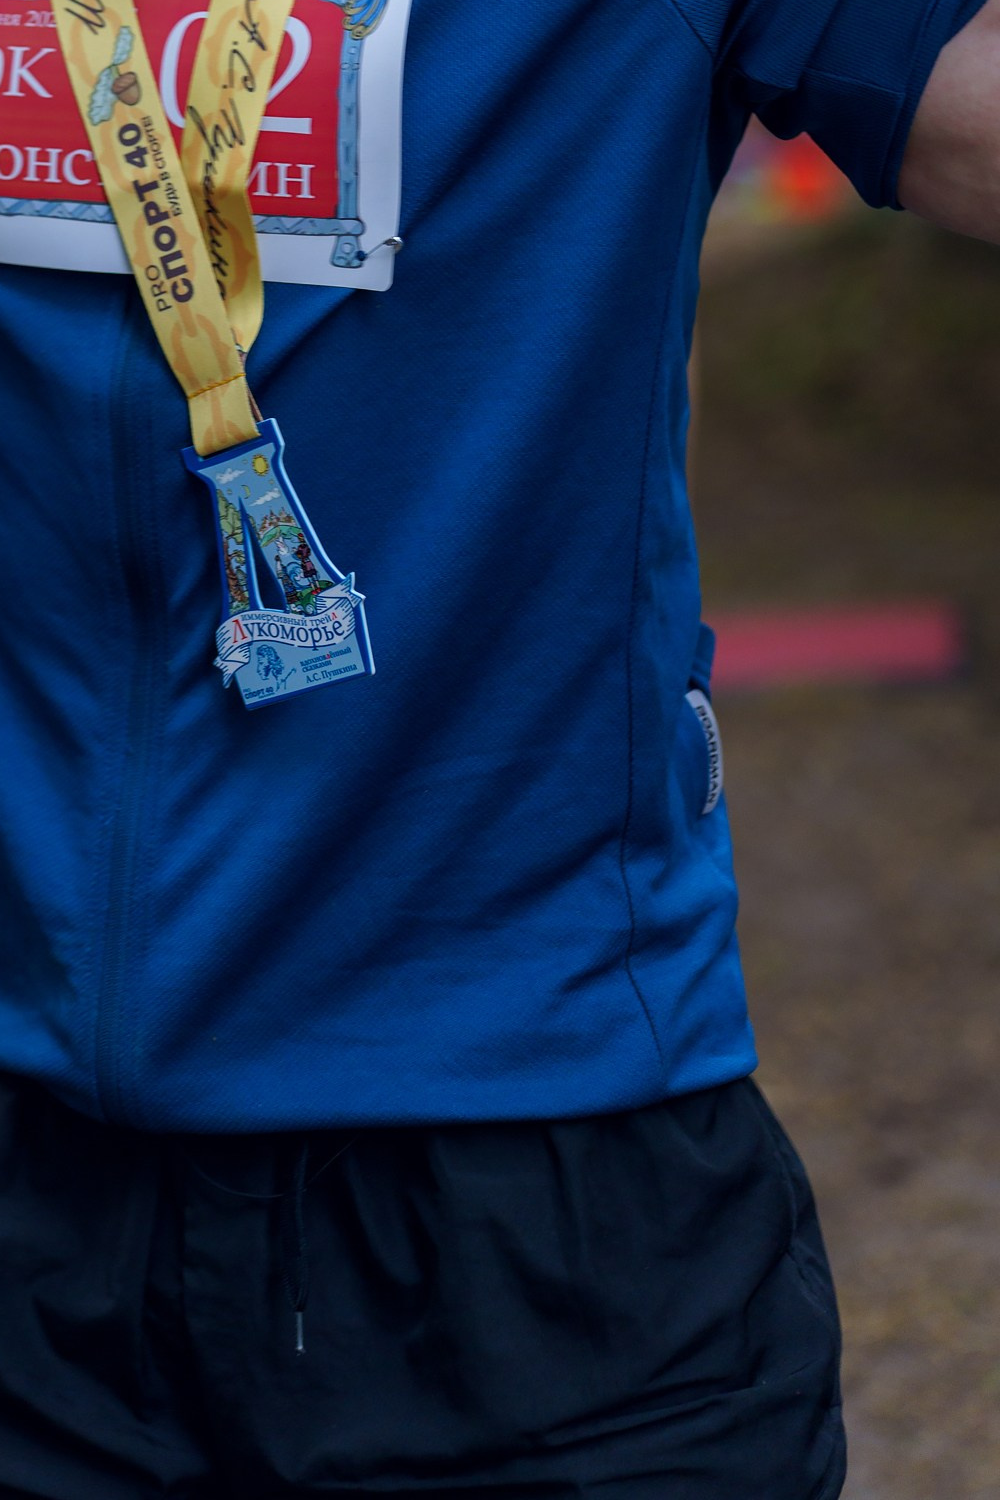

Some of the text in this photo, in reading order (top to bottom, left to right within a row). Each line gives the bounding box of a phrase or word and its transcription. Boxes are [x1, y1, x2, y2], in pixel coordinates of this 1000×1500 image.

[118, 122, 194, 304] СПОРТ 40
[163, 180, 183, 217] БУДЬ
[145, 264, 173, 313] PRO
[232, 618, 345, 651] Лукоморье
[240, 612, 338, 628] иммерсивный трейл
